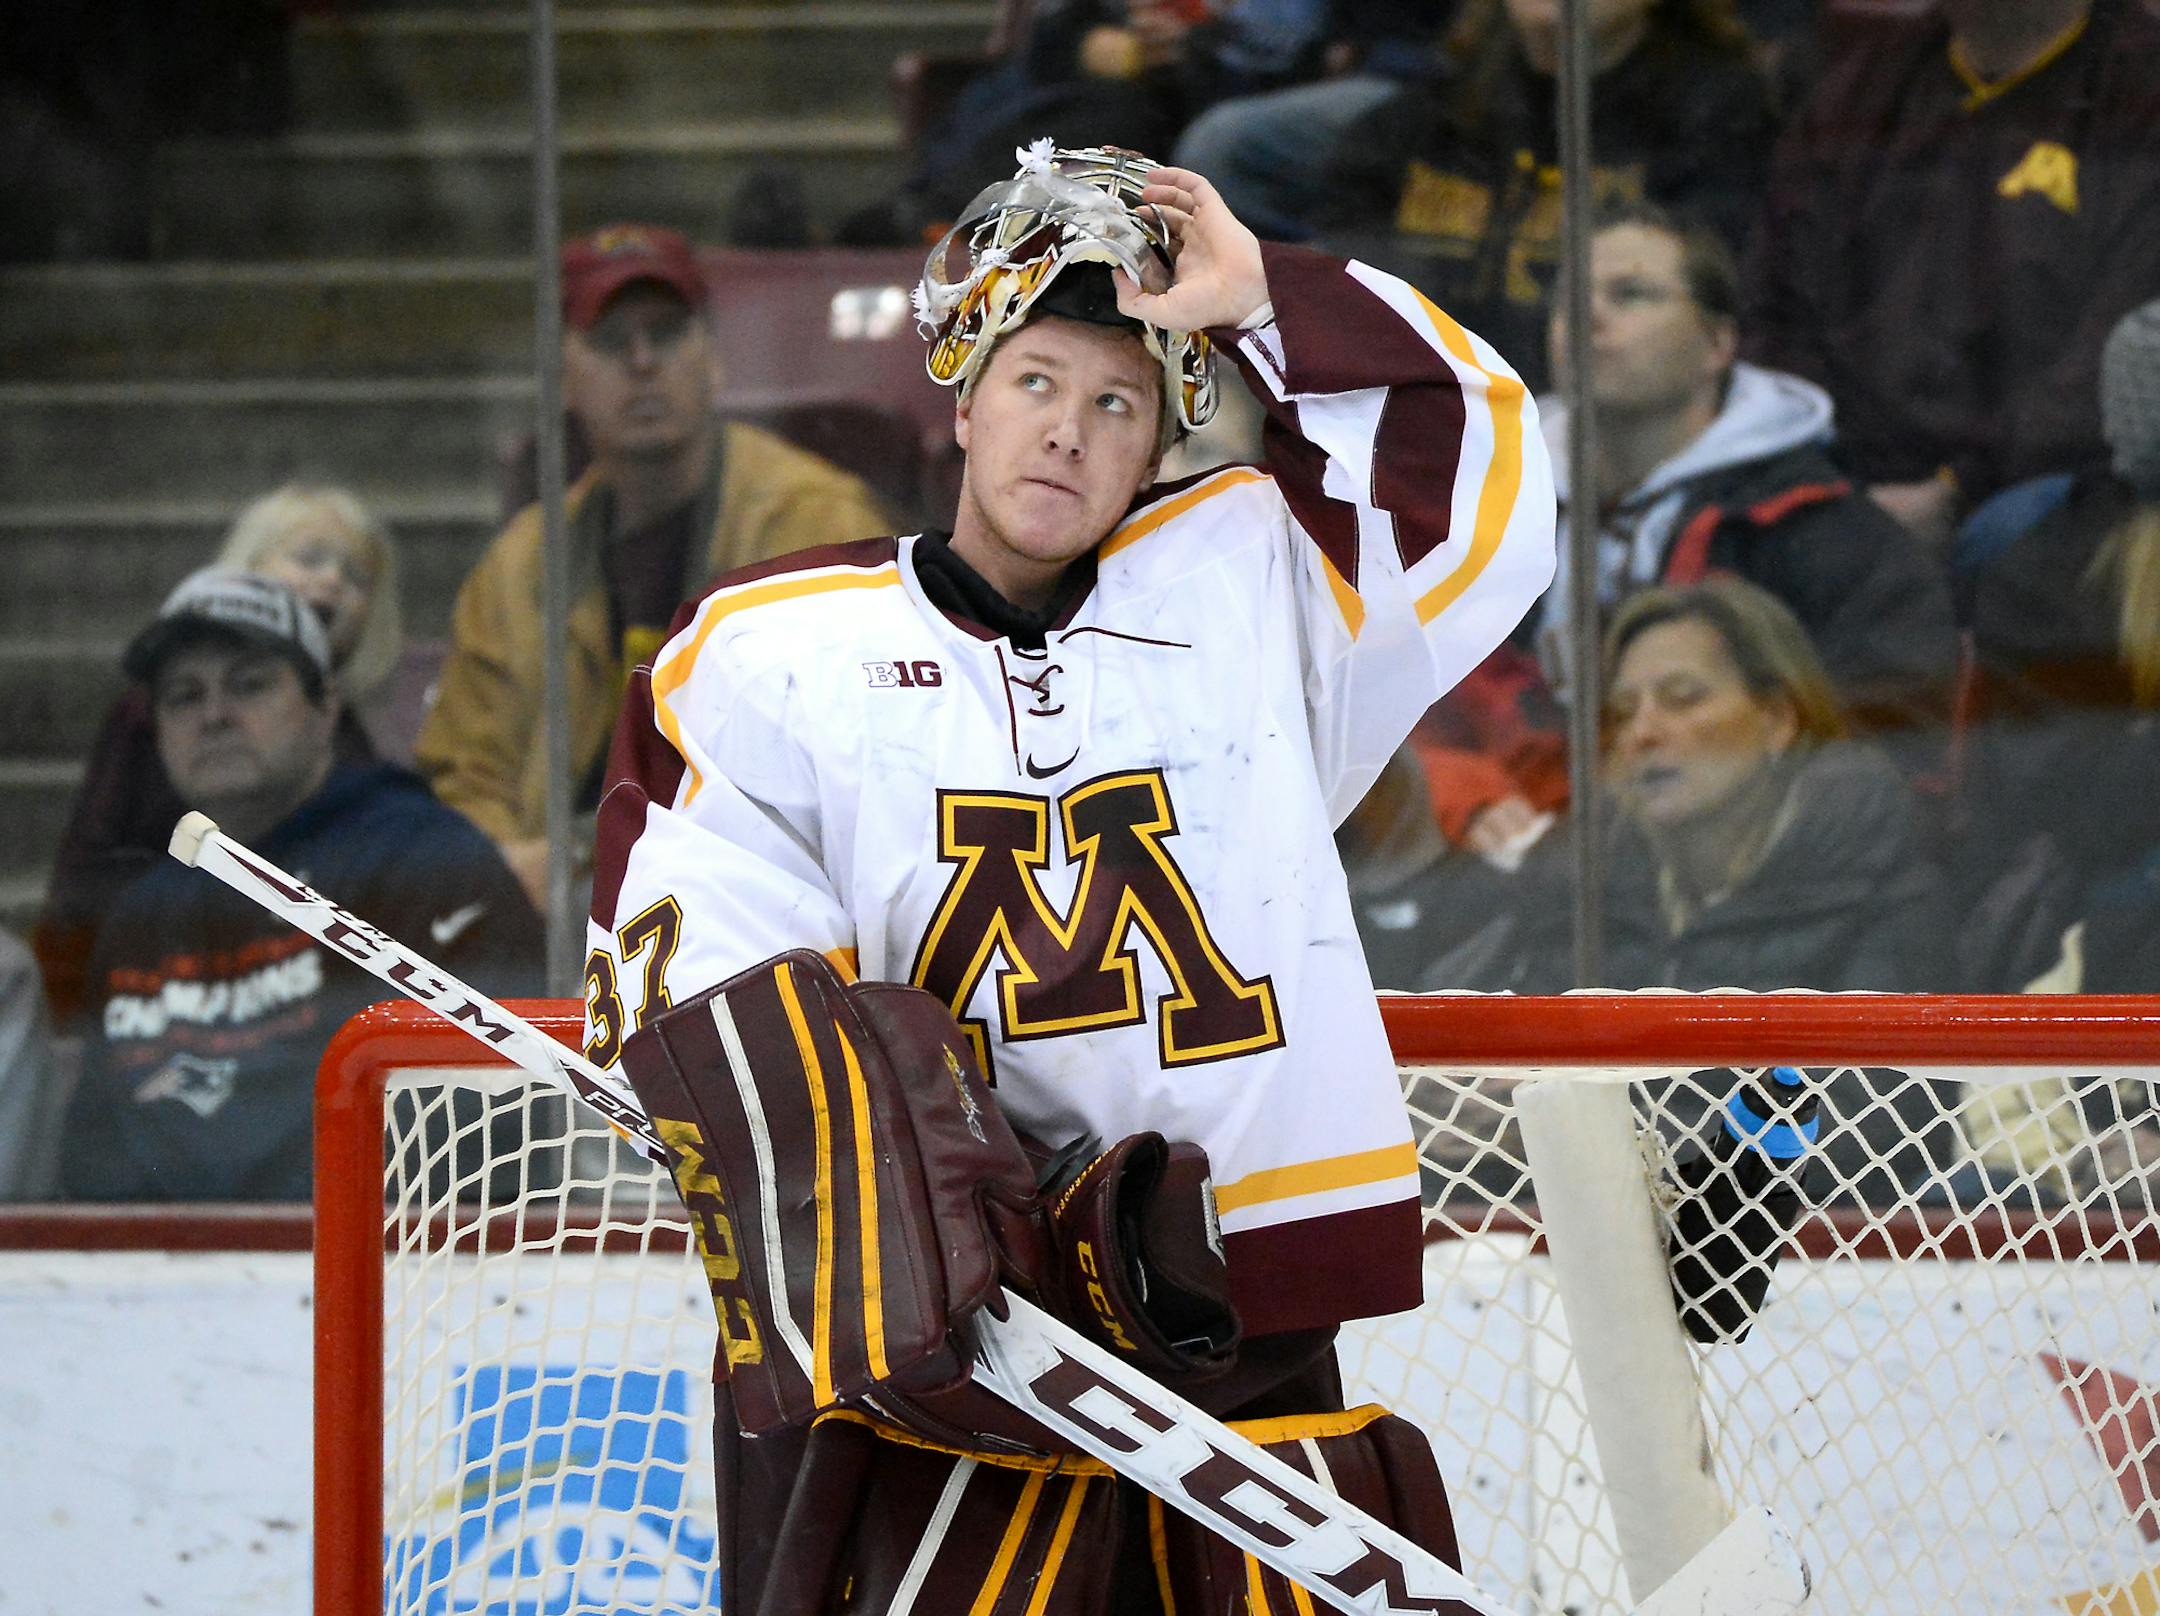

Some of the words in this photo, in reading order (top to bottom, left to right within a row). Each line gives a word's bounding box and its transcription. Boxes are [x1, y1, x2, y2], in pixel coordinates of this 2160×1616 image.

[322, 917, 515, 1044] CCM
[584, 894, 684, 1071] 37
[909, 767, 1287, 1088] M
[653, 1116, 764, 1374] CCM
[1077, 1240, 1138, 1351] CCM
